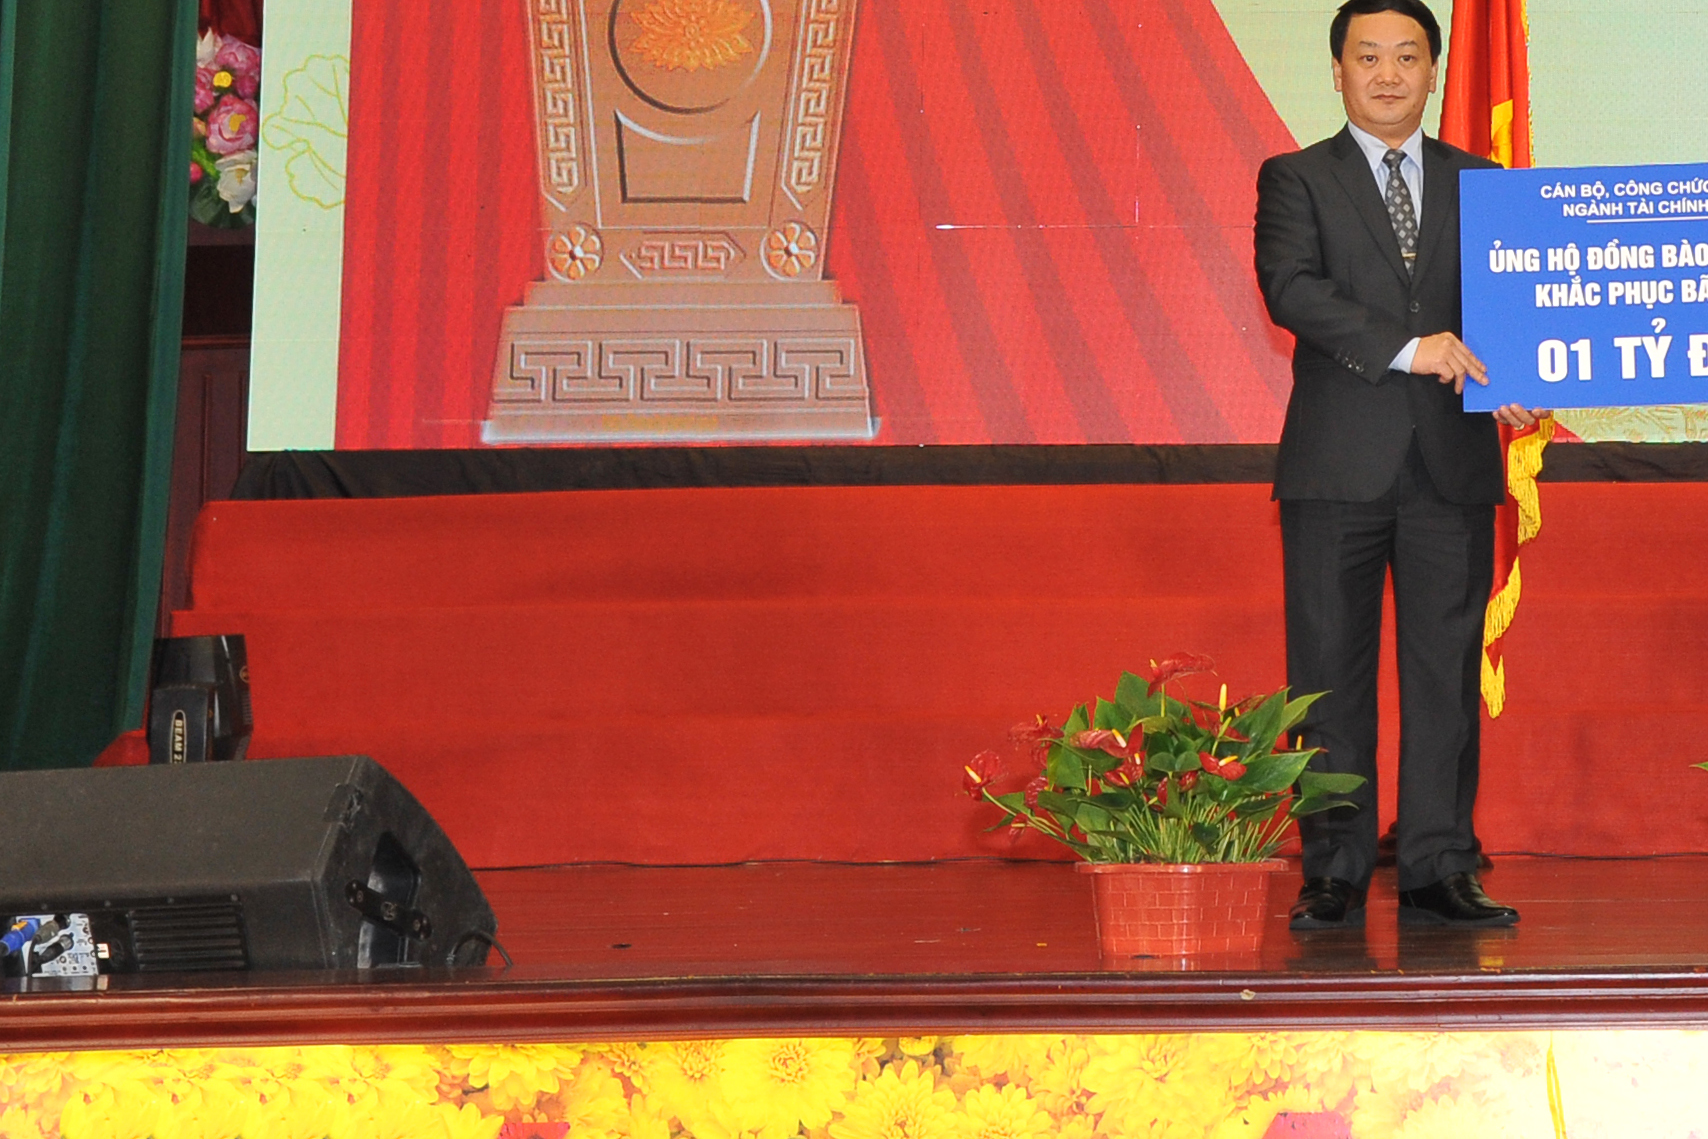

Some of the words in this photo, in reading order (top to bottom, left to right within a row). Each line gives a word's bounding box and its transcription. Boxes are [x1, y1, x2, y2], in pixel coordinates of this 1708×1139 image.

[1540, 179, 1576, 200] CÁN
[1580, 179, 1609, 203] BỘ,
[1613, 179, 1664, 197] CÔNG
[1562, 199, 1624, 217] NGÀNH
[1626, 197, 1655, 215] TÀI
[1489, 240, 1541, 273] ỦNG
[1547, 242, 1581, 276] HỘ
[1586, 238, 1655, 271] ĐỒNG
[1535, 275, 1602, 308] KHẮC
[1607, 279, 1674, 309] PHỤC
[1537, 338, 1592, 383] 01
[1613, 318, 1673, 380] TỶ
[174, 719, 183, 752] BEAM
